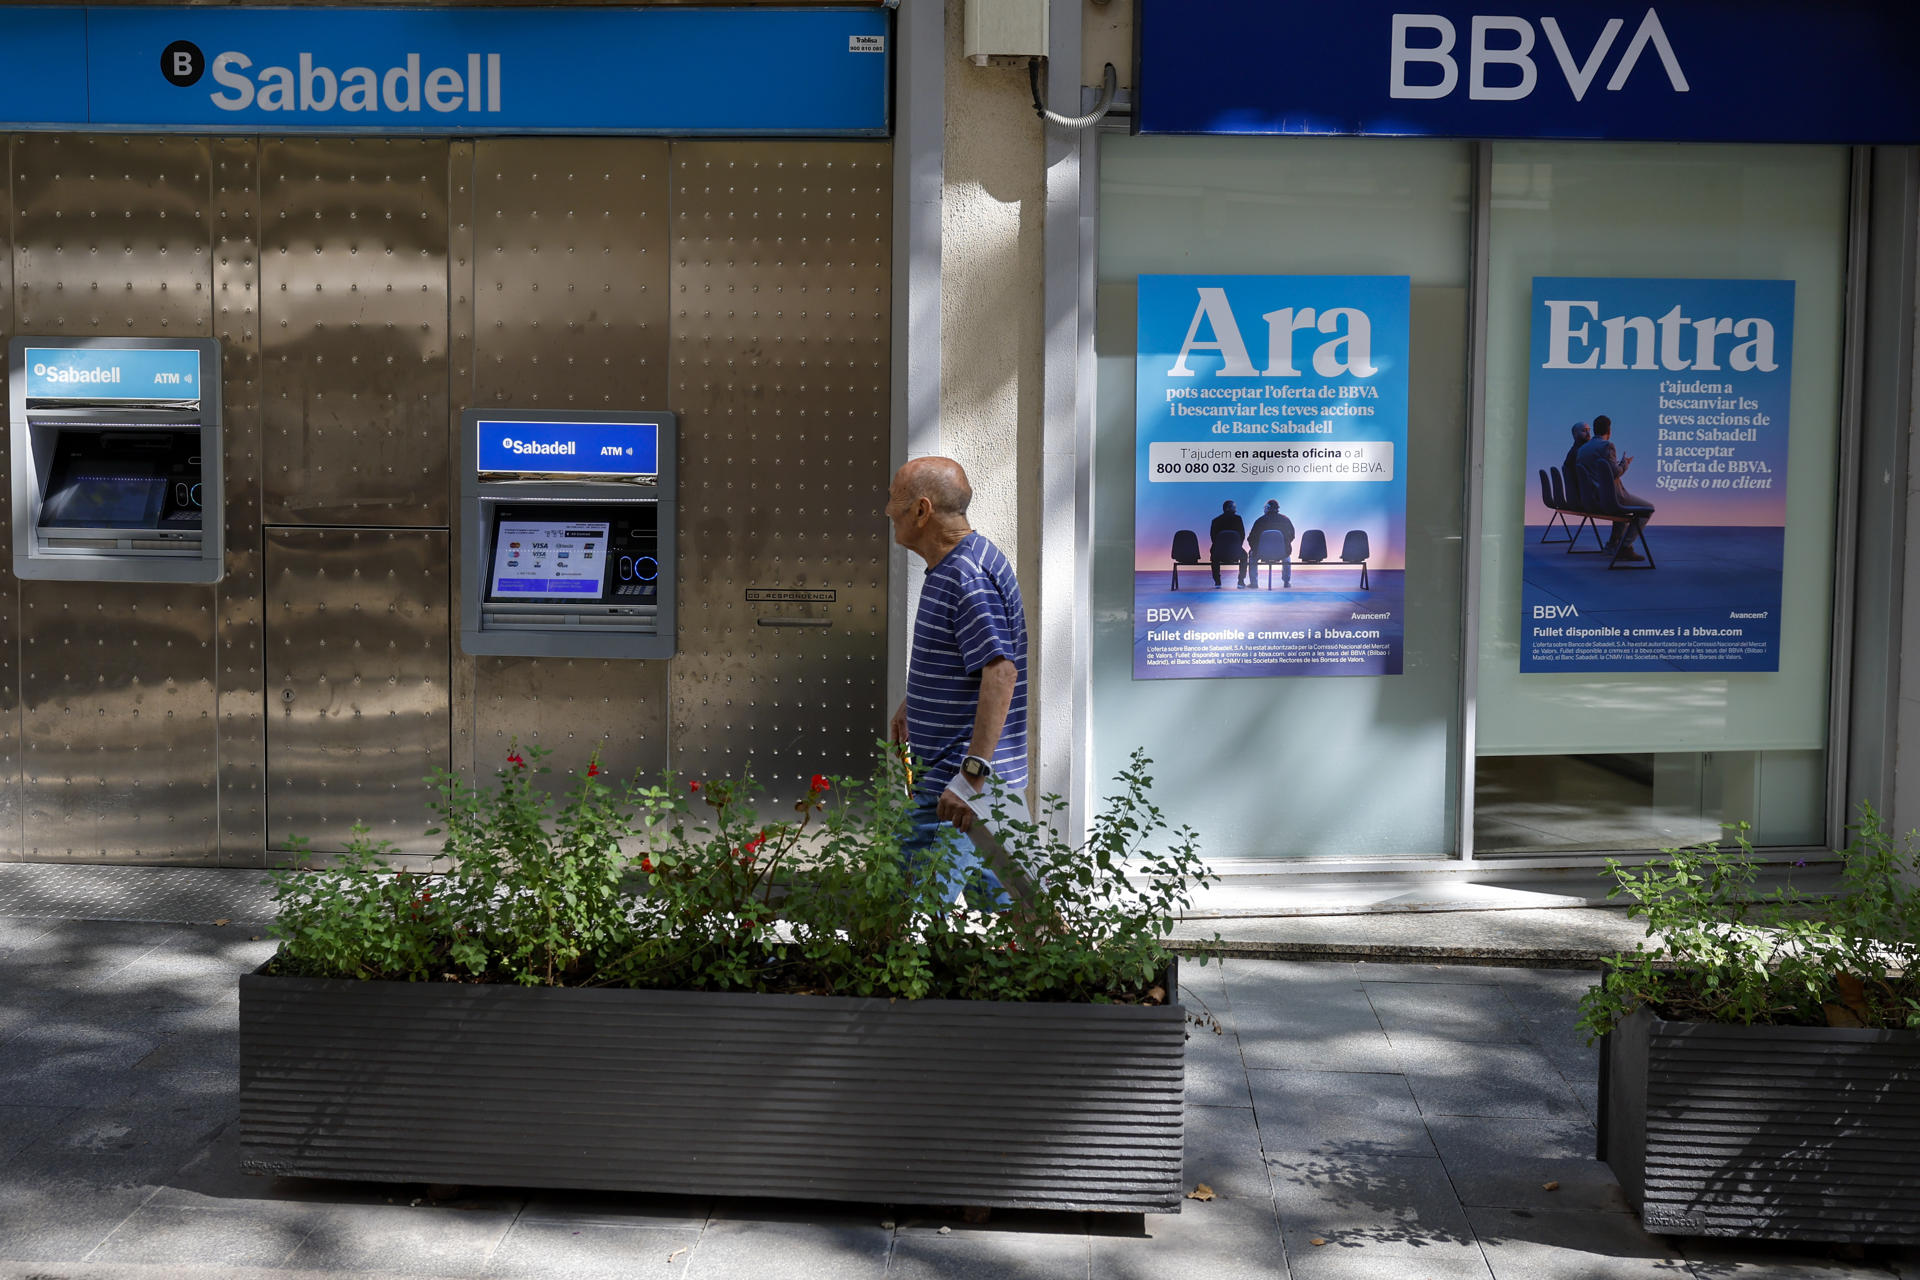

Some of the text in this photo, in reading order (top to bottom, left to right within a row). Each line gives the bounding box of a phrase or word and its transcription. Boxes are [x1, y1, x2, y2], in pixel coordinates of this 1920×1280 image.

[1390, 7, 1690, 101] BBVA
[174, 51, 501, 112] B Sabadell
[1167, 288, 1379, 378] Ara
[1542, 300, 1779, 372] Entra
[46, 367, 120, 383] Sabadell
[154, 373, 180, 384] ATM
[1166, 386, 1198, 401] pots
[1200, 387, 1263, 401] acceptar
[1318, 385, 1336, 398] de
[1338, 386, 1379, 398] BBVA
[1724, 384, 1733, 393] a
[1170, 403, 1374, 416] i bescanviar les teves accions
[1659, 396, 1758, 409] bescanviar les
[1659, 413, 1770, 425] teves accions de
[1212, 420, 1333, 435] de Banc Sabadell
[1658, 428, 1757, 441] Banc Sabadell
[513, 440, 575, 455] Sabadell
[600, 447, 622, 456] ATM
[1252, 450, 1299, 460] aquesta
[1302, 449, 1342, 458] oficina
[1353, 449, 1363, 457] al
[1657, 444, 1735, 459] i a acceptar
[1157, 463, 1181, 473] 800
[1185, 463, 1209, 473] 080
[1241, 463, 1274, 474] Siguis
[1277, 465, 1284, 473] o
[1286, 465, 1300, 473] no
[1303, 463, 1333, 473] client
[1336, 463, 1349, 472] de
[1351, 463, 1386, 472] BBVA.
[1708, 460, 1725, 472] de
[1728, 461, 1772, 472] BBVA.
[1656, 476, 1772, 490] Siguis o no client
[1147, 606, 1194, 622] BBVA
[1351, 612, 1390, 620] Avancem?
[1533, 604, 1579, 619] BBVA
[1730, 611, 1768, 619] Avancem?
[1148, 631, 1180, 640] Fullet
[1183, 628, 1245, 642] disponible
[1258, 631, 1304, 639] cnmv.es
[1308, 628, 1311, 638] i
[1324, 629, 1380, 638] bbva.com
[1534, 628, 1563, 636] Fullet
[1566, 627, 1620, 638] disponible
[1677, 627, 1681, 636] i
[1693, 627, 1742, 636] bbva.com
